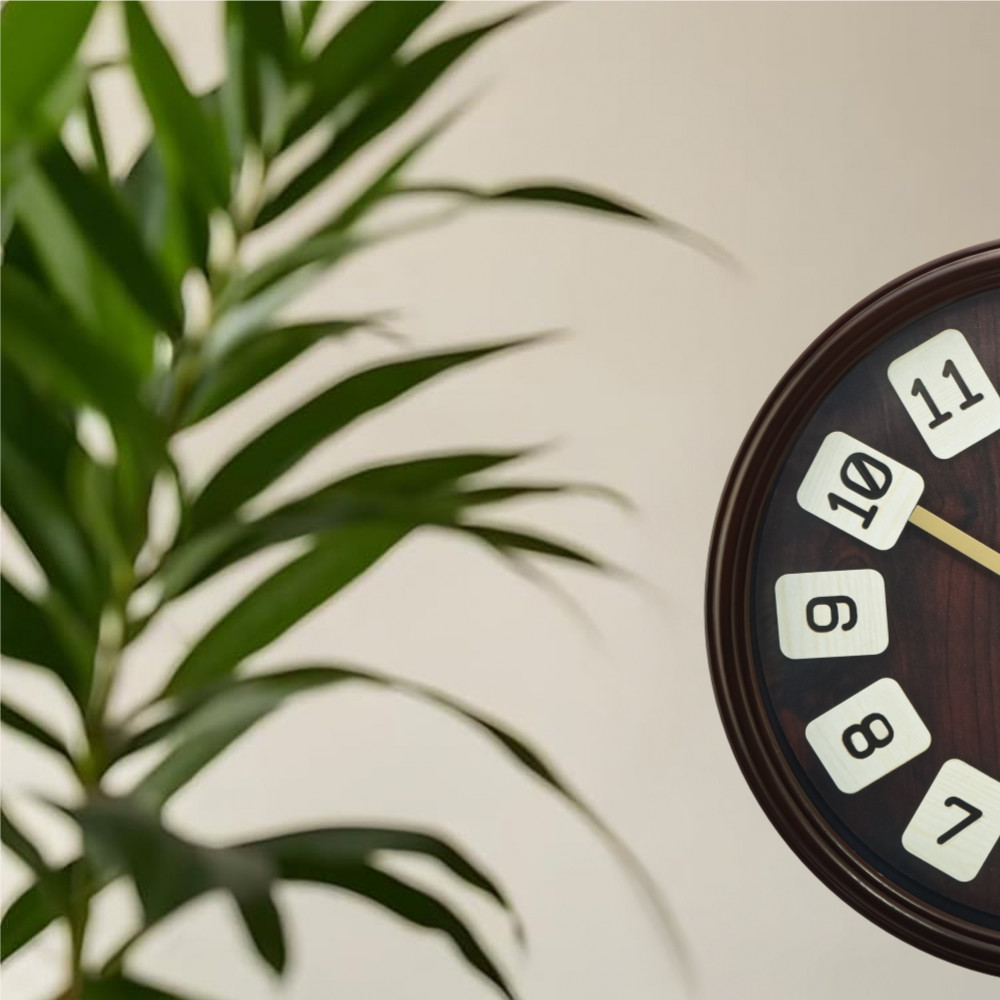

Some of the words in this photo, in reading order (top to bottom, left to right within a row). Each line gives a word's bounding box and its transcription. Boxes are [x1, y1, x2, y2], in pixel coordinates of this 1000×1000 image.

[911, 359, 985, 431] 11
[827, 452, 894, 531] 10
[805, 595, 859, 634] 9
[841, 712, 896, 761] 8
[936, 796, 984, 846] 7
